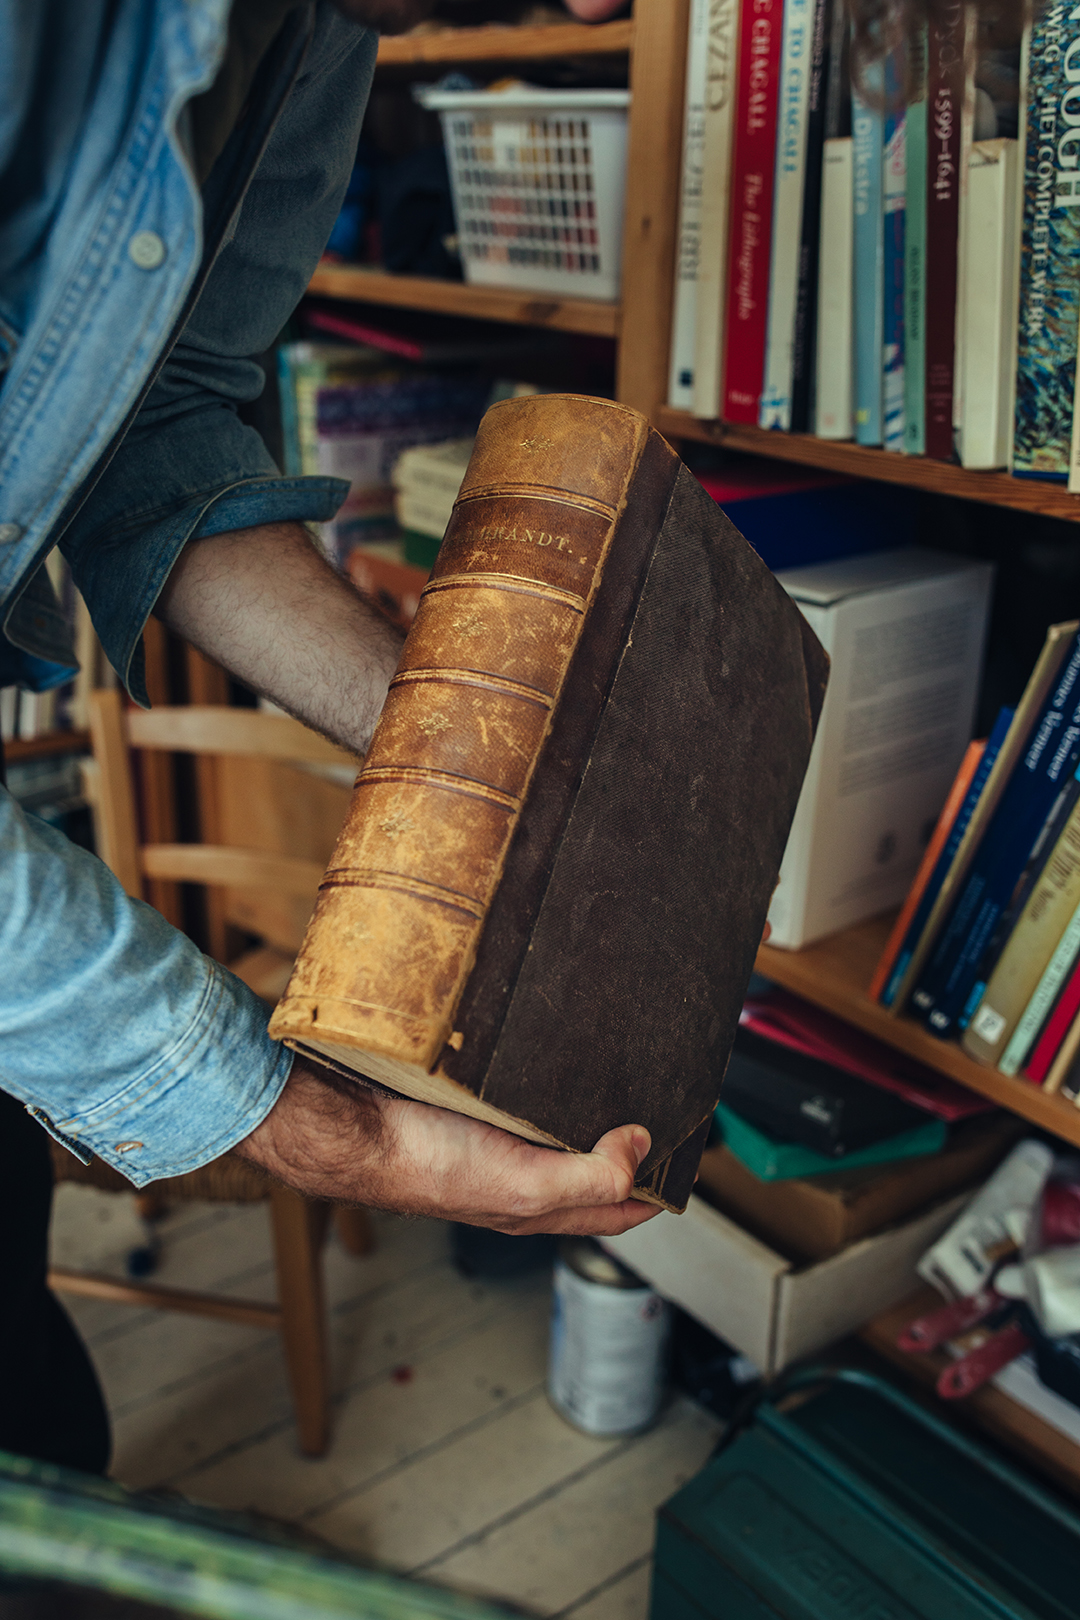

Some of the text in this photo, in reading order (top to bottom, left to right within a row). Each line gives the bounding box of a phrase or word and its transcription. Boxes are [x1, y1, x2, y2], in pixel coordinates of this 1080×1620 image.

[746, 19, 772, 135] CHAGALL
[789, 28, 805, 58] TO
[782, 67, 804, 178] CHAGALL
[854, 116, 874, 215] Dijkstra
[1025, 5, 1065, 338] WEG HET COMPLETE WERK
[742, 173, 764, 208] The
[735, 210, 761, 320] Lithographs
